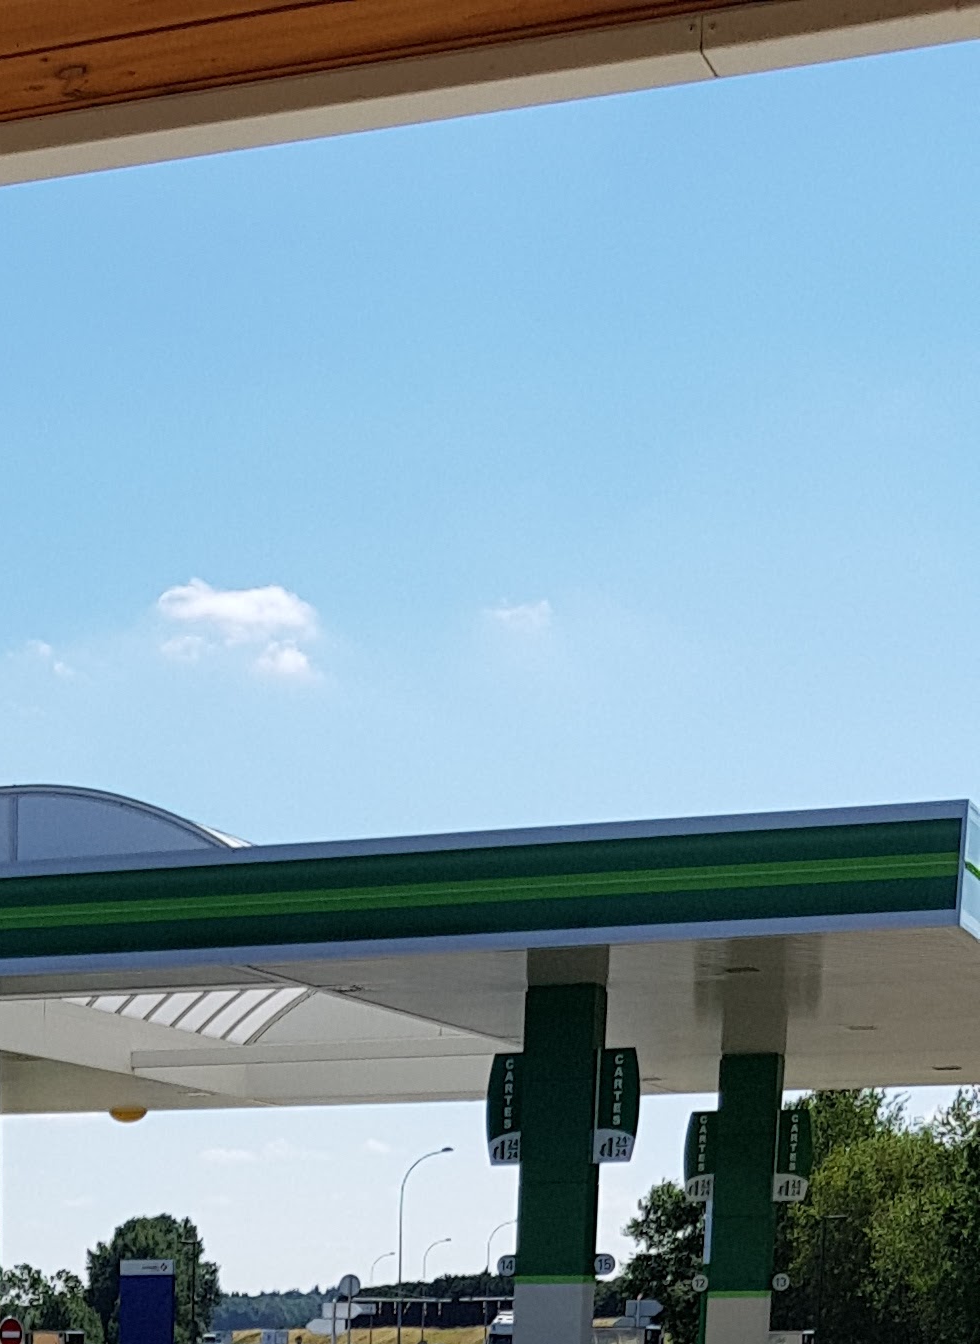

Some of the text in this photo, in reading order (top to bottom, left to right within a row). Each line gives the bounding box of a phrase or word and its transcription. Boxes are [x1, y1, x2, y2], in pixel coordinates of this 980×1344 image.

[503, 1058, 515, 1130] CARTES
[612, 1054, 624, 1126] CARTES
[508, 1139, 518, 1148] 24
[615, 1136, 627, 1145] 24
[698, 1115, 708, 1172] CARTES
[788, 1114, 799, 1171] CARTES
[507, 1151, 518, 1160] 24
[614, 1148, 626, 1157] 24
[501, 1260, 513, 1271] 14
[599, 1259, 612, 1271] 15
[695, 1278, 705, 1288] 12
[776, 1277, 787, 1287] 13
